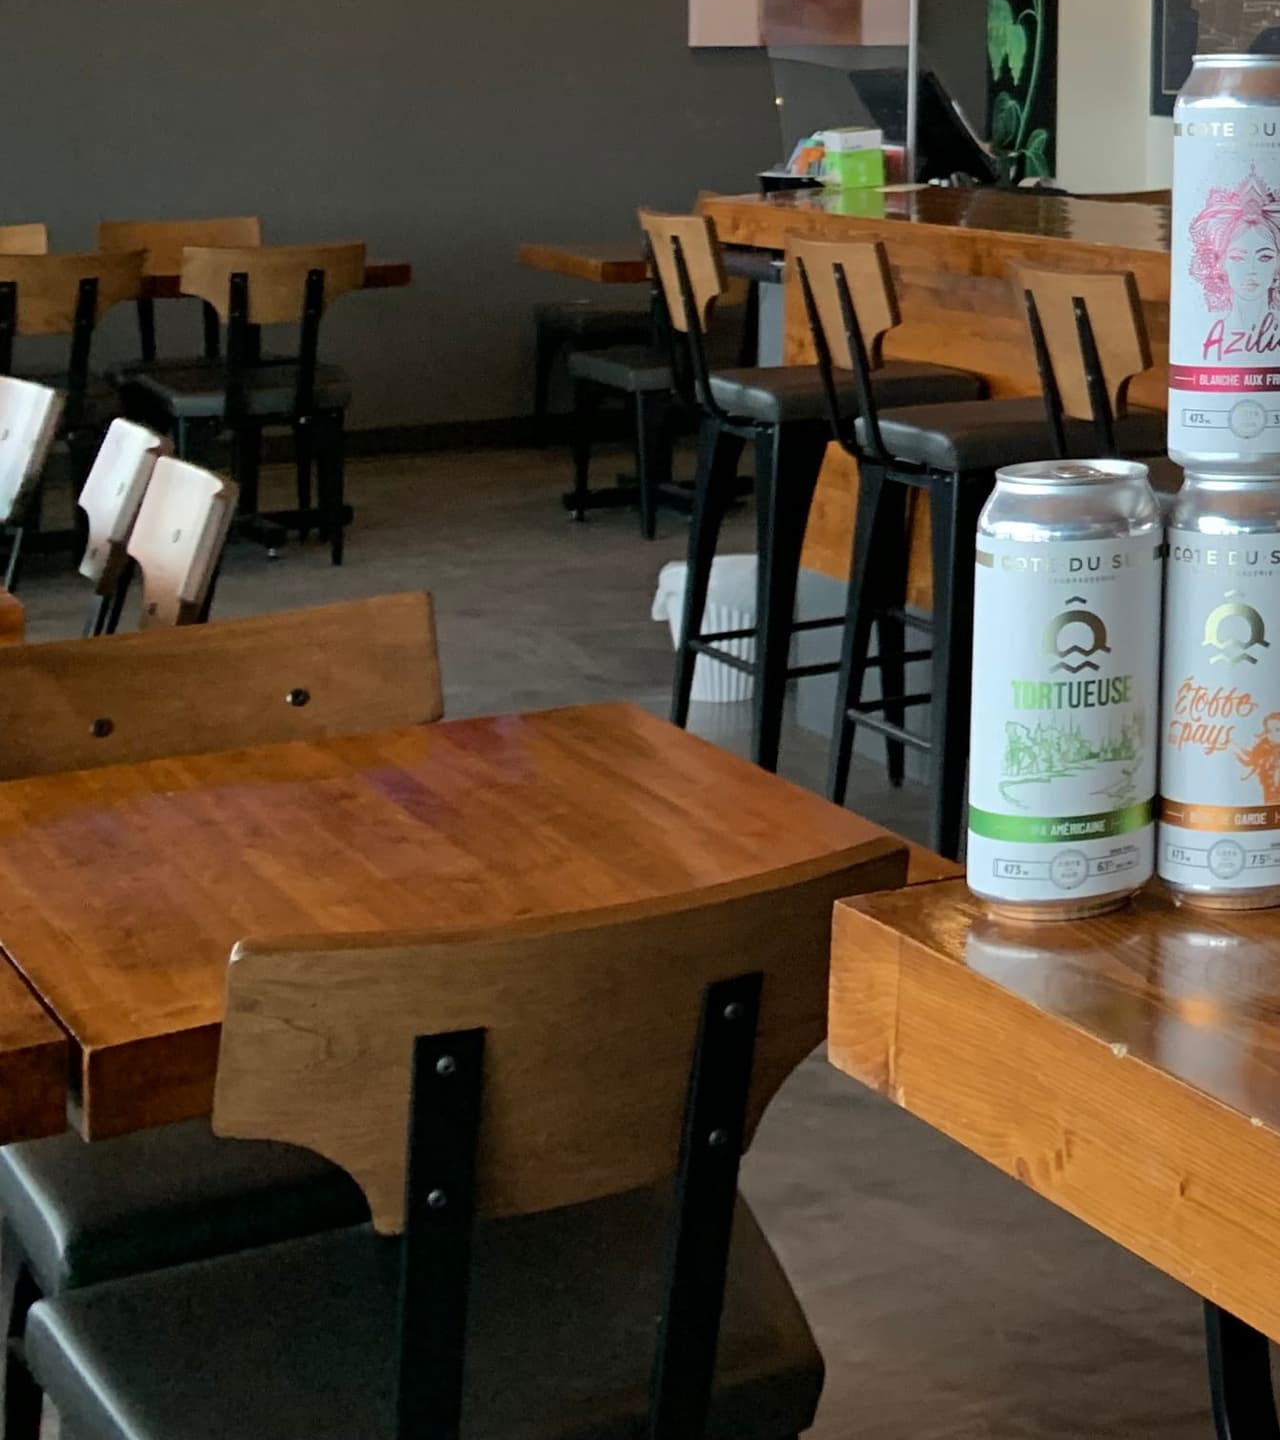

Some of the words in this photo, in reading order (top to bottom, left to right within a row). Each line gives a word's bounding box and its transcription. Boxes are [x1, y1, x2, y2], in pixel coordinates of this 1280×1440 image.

[1243, 373, 1263, 386] AUX
[1069, 555, 1100, 572] DU
[1011, 675, 1133, 711] TORTUEUSE
